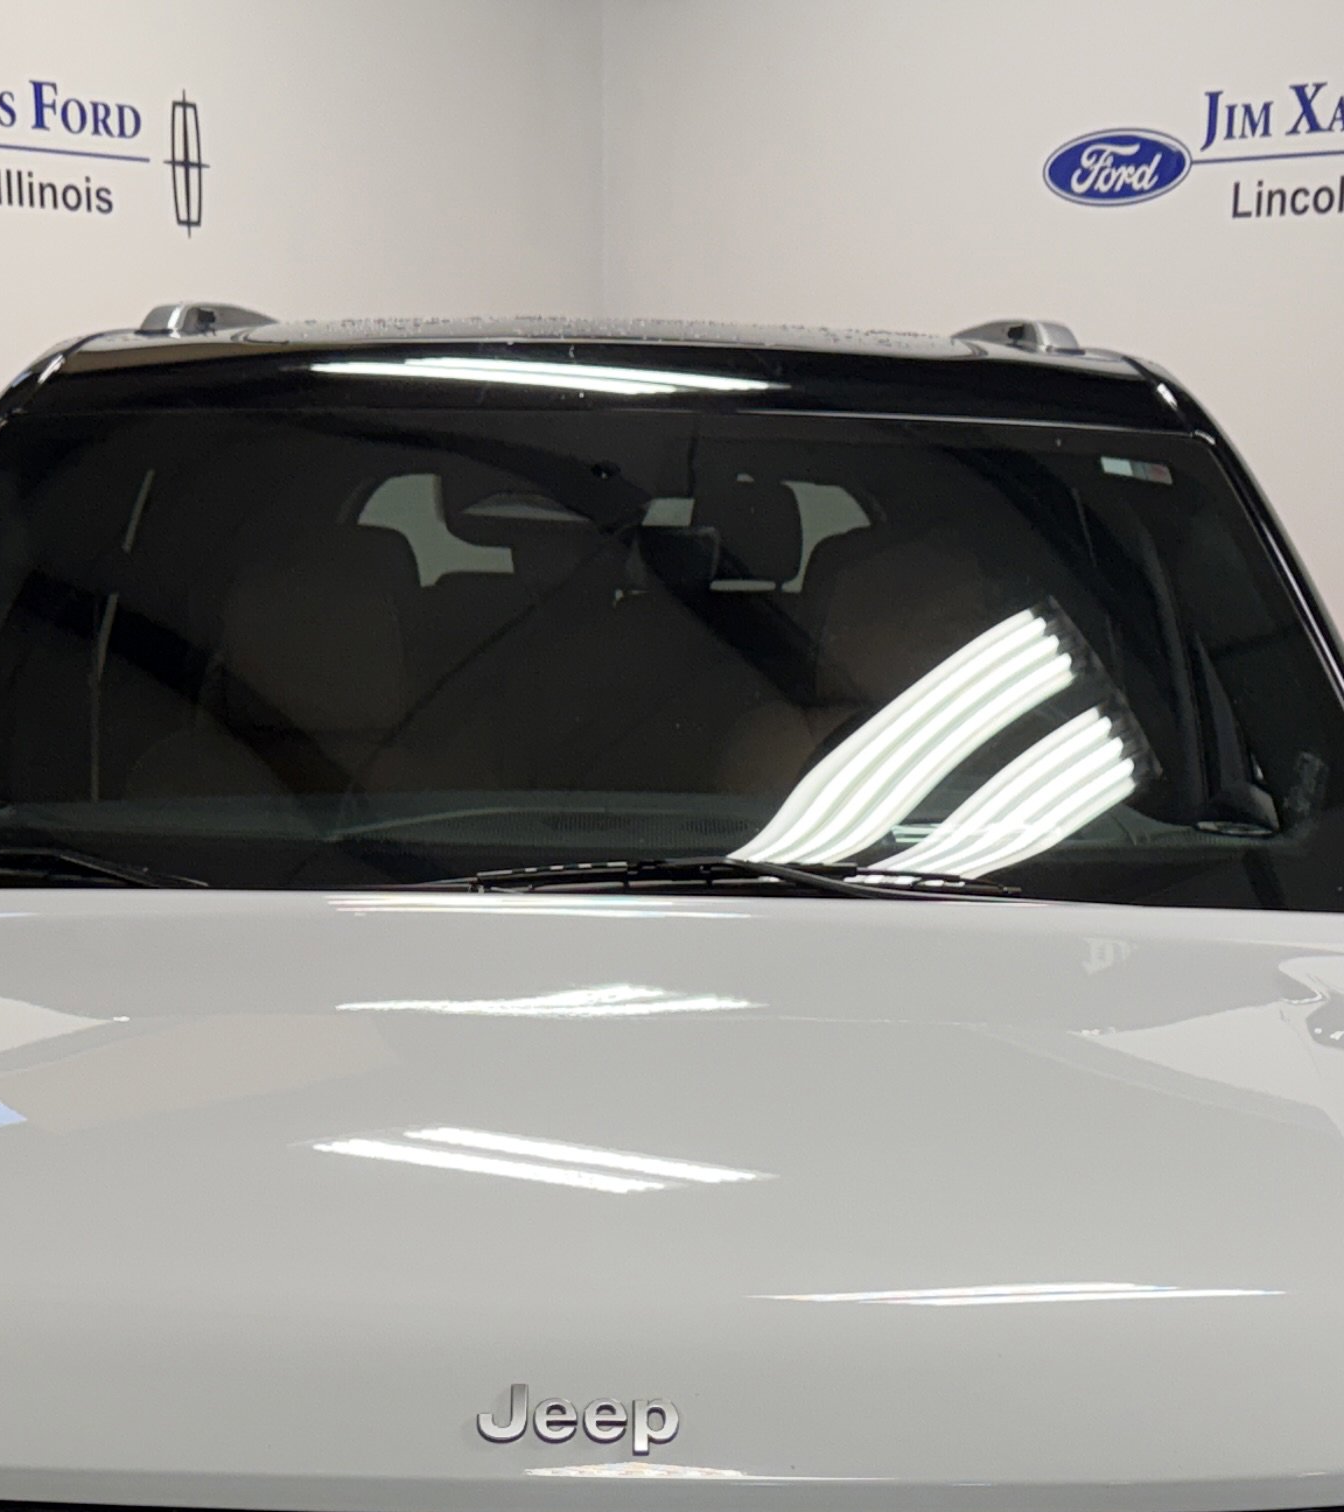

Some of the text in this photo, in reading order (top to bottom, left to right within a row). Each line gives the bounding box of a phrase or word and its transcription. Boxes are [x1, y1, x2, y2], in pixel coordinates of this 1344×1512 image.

[29, 80, 142, 139] FORD
[1201, 90, 1273, 151] JIM
[1070, 143, 1159, 194] Ford
[476, 1383, 680, 1456] Jeep
